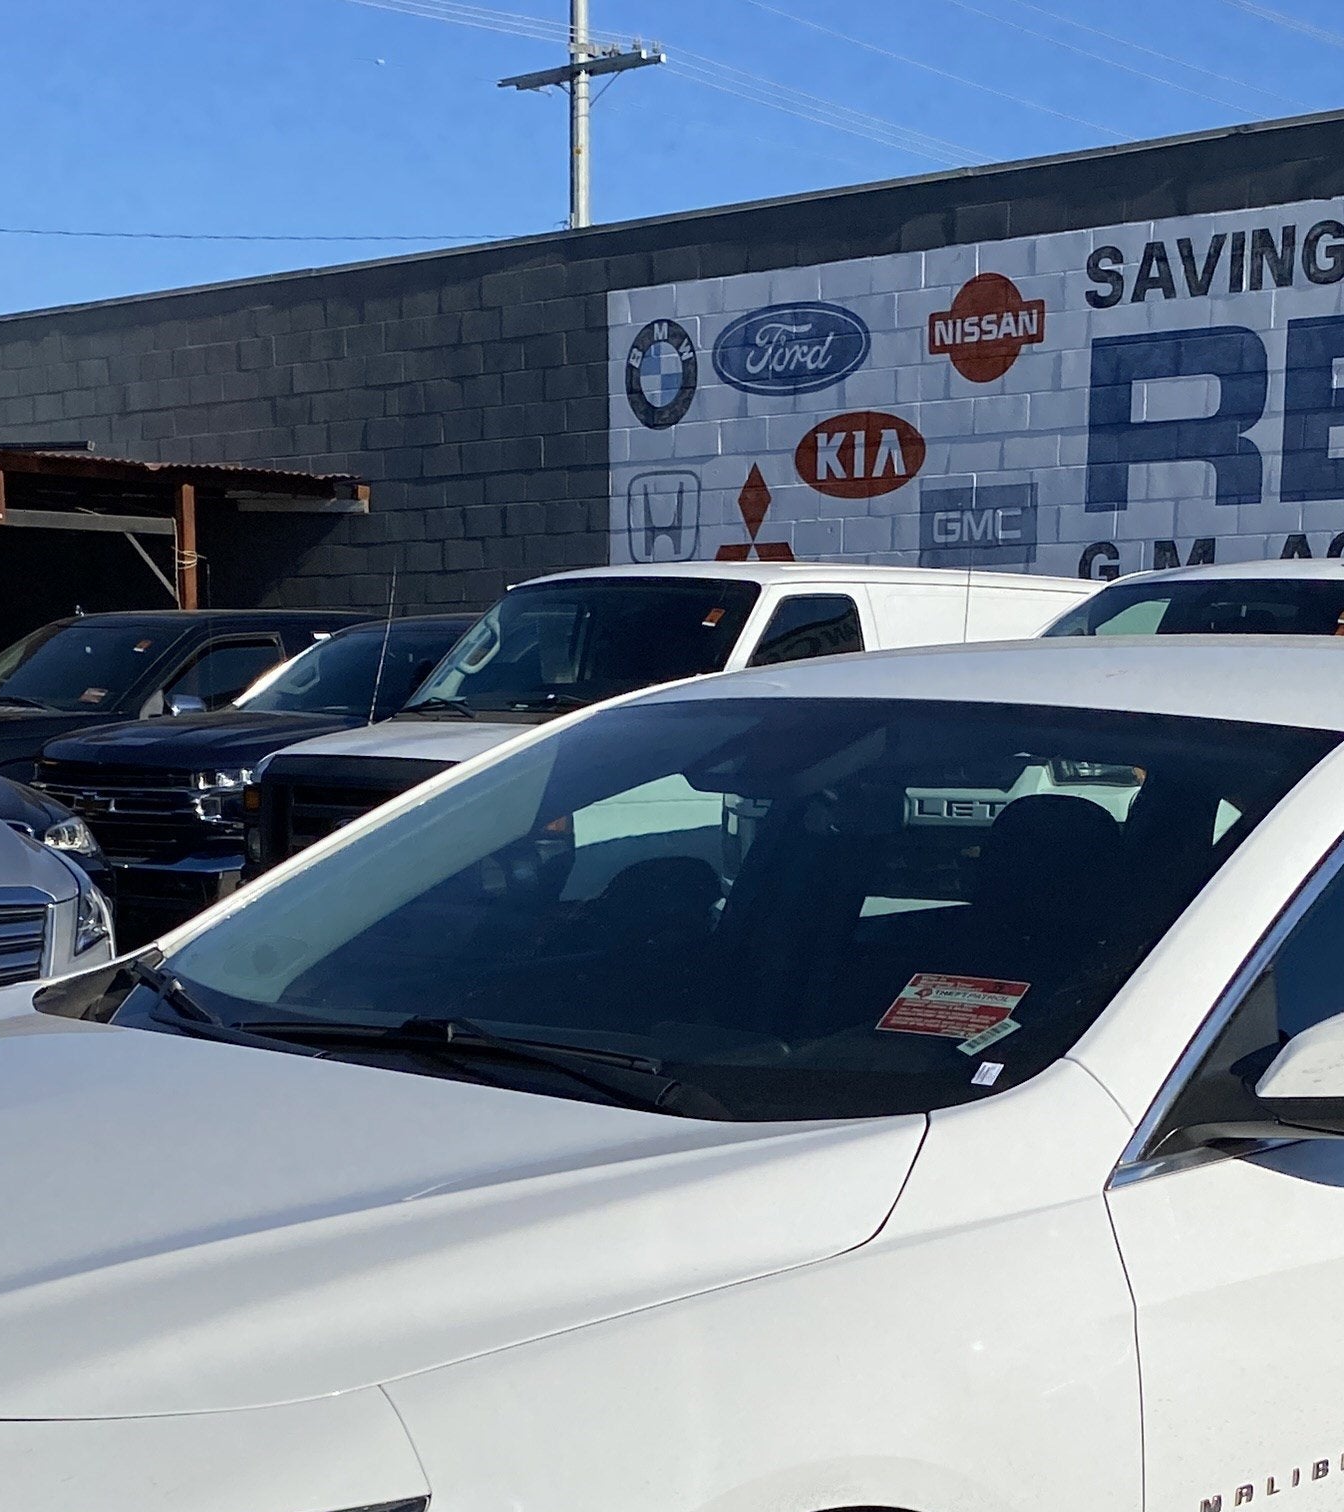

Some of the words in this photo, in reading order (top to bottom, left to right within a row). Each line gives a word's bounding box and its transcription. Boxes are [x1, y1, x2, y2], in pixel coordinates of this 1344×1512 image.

[627, 321, 695, 370] BMW
[746, 322, 834, 374] Ford
[934, 309, 1039, 347] NISSAN
[815, 428, 906, 481] KIA
[932, 507, 1023, 544] GMC
